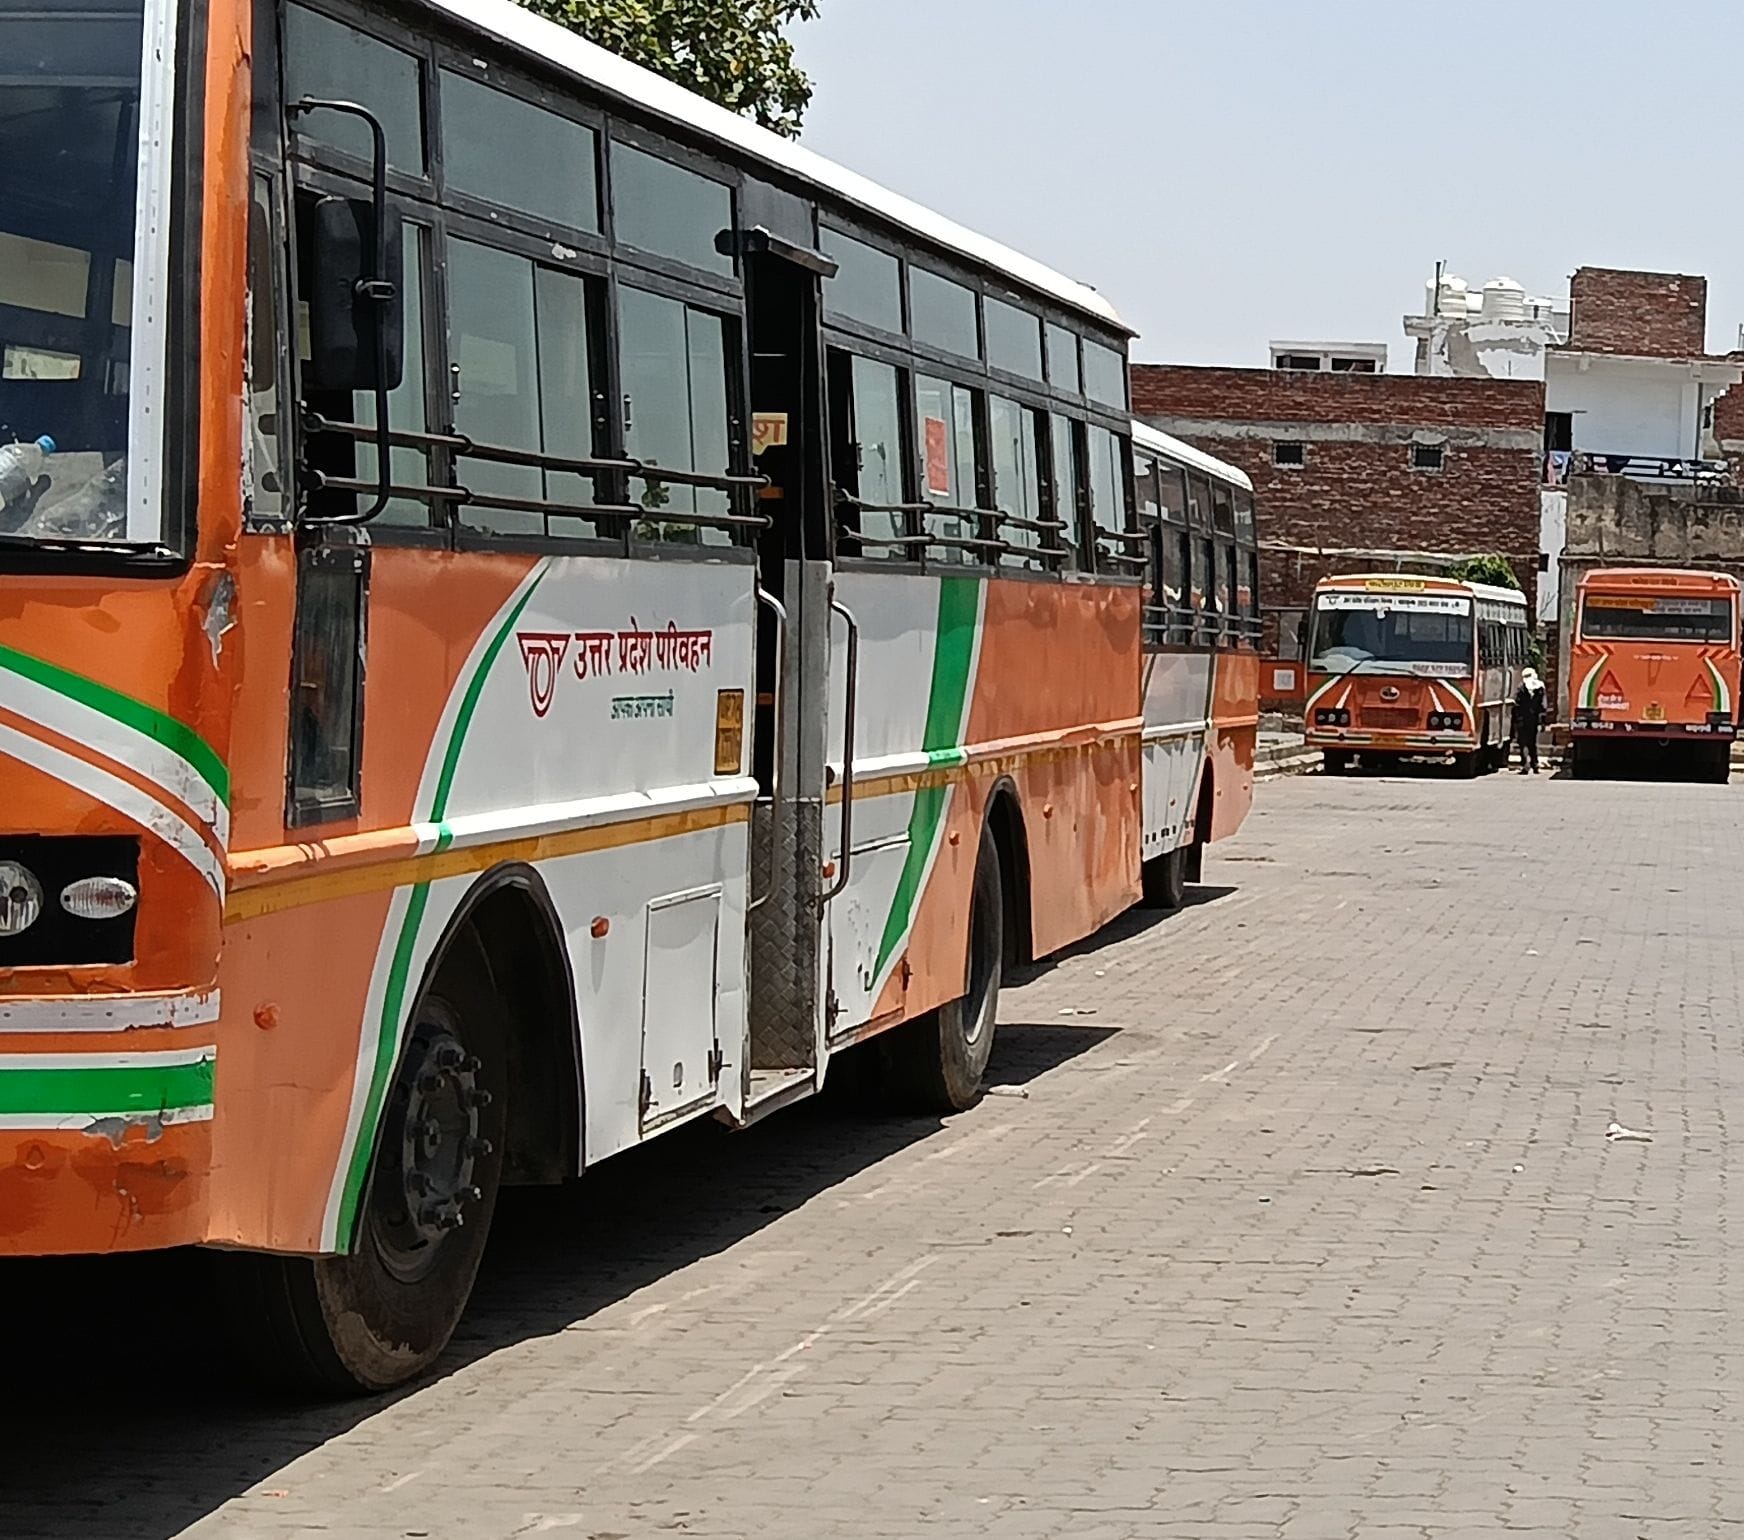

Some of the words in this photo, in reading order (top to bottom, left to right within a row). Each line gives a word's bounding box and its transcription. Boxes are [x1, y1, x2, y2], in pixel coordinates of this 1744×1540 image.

[573, 632, 614, 680] उत्तर
[617, 616, 654, 676] प्रदेश
[654, 620, 713, 673] परिवहन
